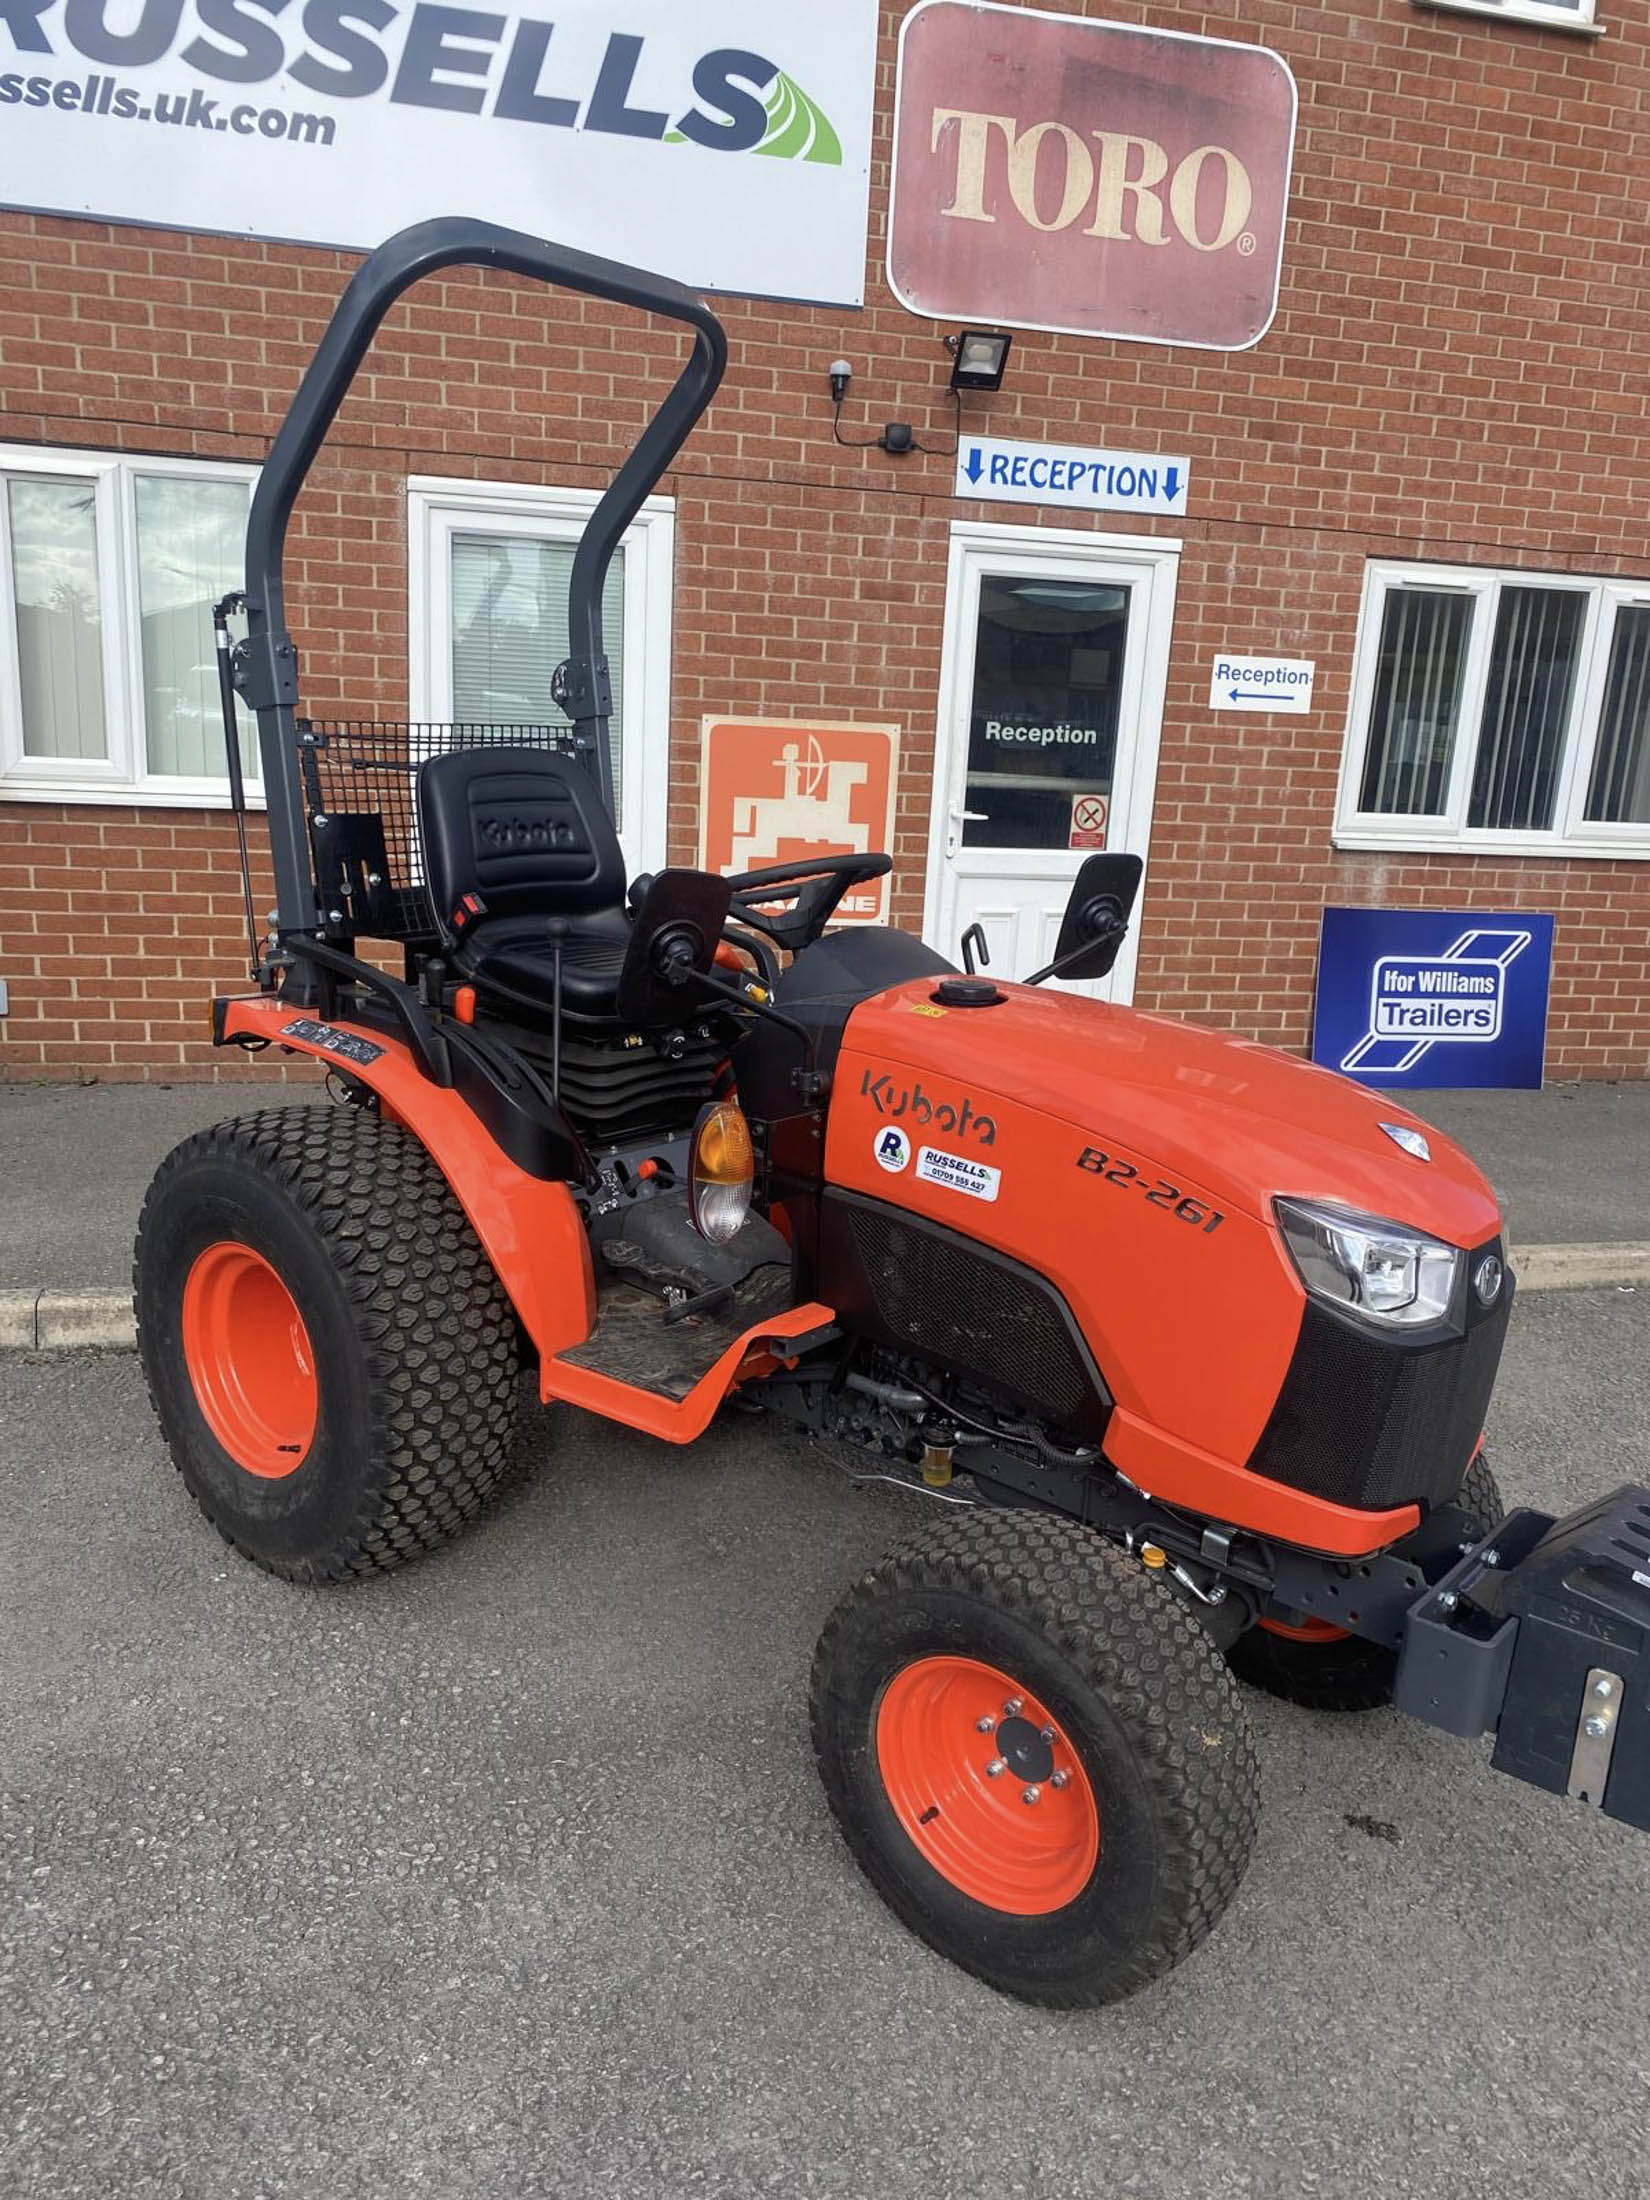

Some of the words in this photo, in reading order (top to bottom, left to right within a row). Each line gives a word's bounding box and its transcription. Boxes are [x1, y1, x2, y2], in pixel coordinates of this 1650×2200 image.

[990, 454, 1158, 498] RECEPTION
[1217, 663, 1309, 686] Reception
[985, 721, 1097, 746] Reception
[1383, 970, 1416, 992] Ifor
[1418, 970, 1495, 994] Williams
[1382, 1002, 1492, 1028] Trailers
[861, 1069, 997, 1146] Kubota
[880, 1131, 902, 1158] R
[925, 1151, 987, 1178] RUSSELLS
[1076, 1146, 1225, 1233] B2-261
